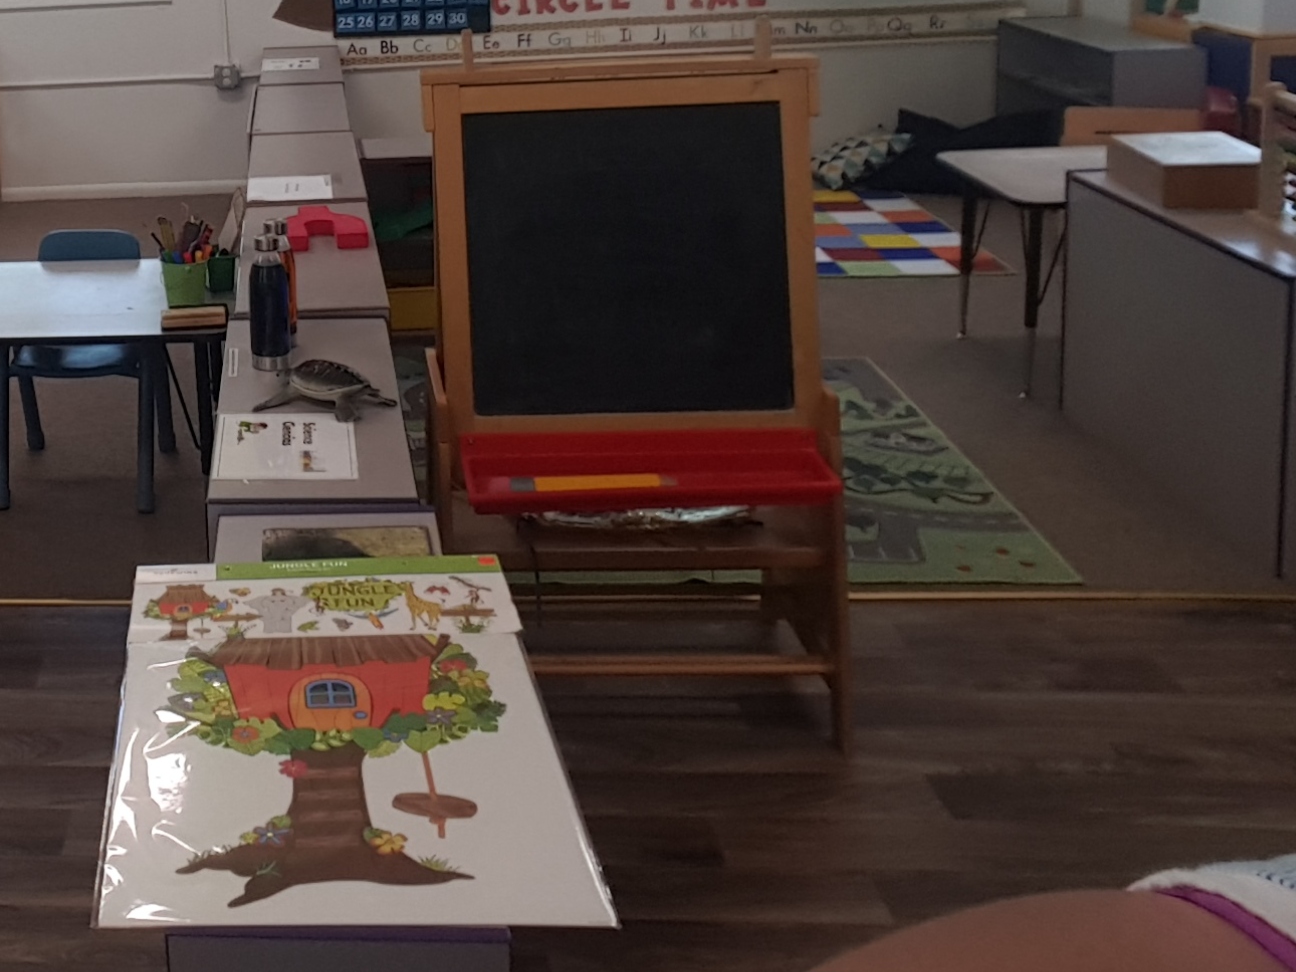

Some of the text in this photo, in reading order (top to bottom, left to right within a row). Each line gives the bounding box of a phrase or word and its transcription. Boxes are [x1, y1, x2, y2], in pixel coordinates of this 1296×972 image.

[338, 12, 466, 28] 25 26 27 28 29 30
[346, 43, 368, 56] Aa
[380, 40, 399, 54] Bb
[413, 39, 432, 53] Cc
[483, 35, 500, 50] Ee
[517, 33, 532, 48] Ff
[620, 28, 632, 42] Ii
[653, 27, 666, 45] Jj
[795, 21, 818, 34] Nn
[270, 562, 320, 570] JUNGLE
[312, 583, 393, 596] JUNGLE
[333, 598, 376, 608] FUN
